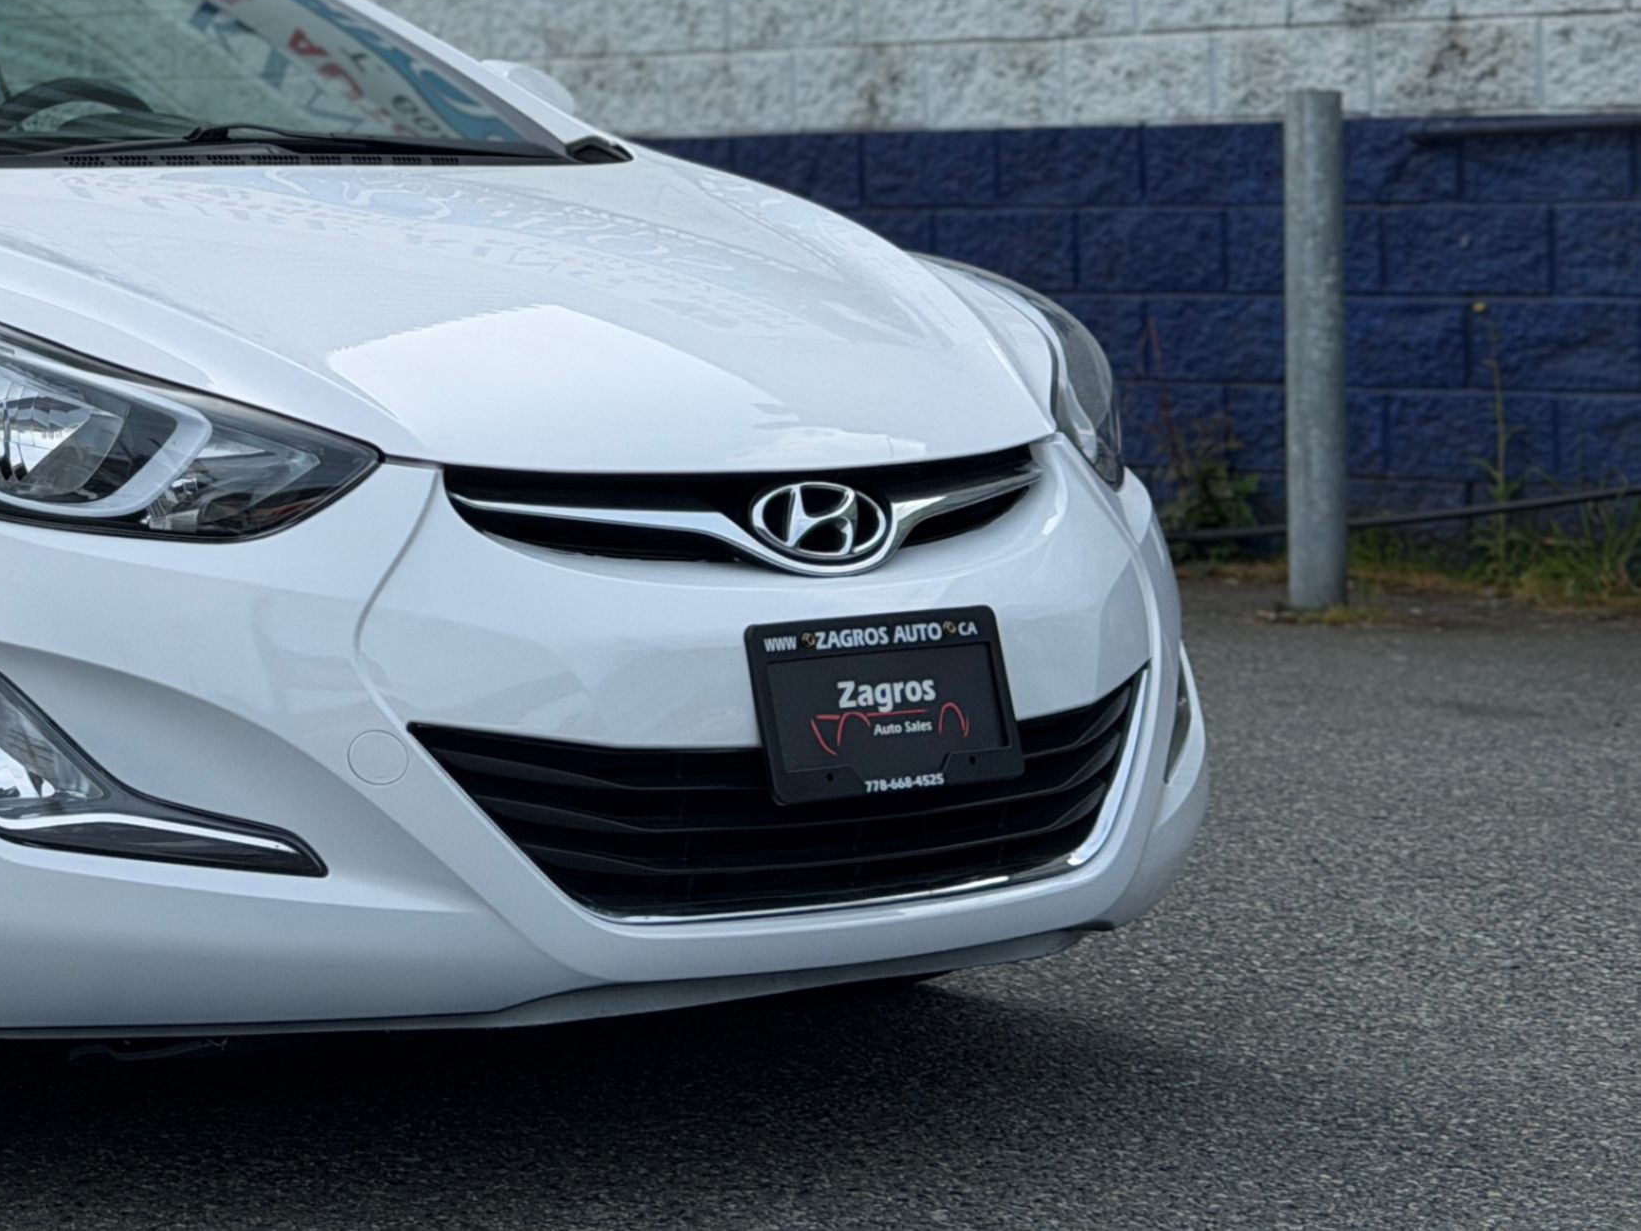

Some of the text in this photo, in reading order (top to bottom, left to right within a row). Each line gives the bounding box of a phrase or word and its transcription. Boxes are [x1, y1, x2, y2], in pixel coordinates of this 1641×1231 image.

[814, 625, 889, 651] ZAGROS
[893, 622, 943, 644] AUTO
[837, 679, 937, 713] Zagros
[873, 719, 933, 737] Auto Sales
[864, 772, 945, 793] 778-668-4525
